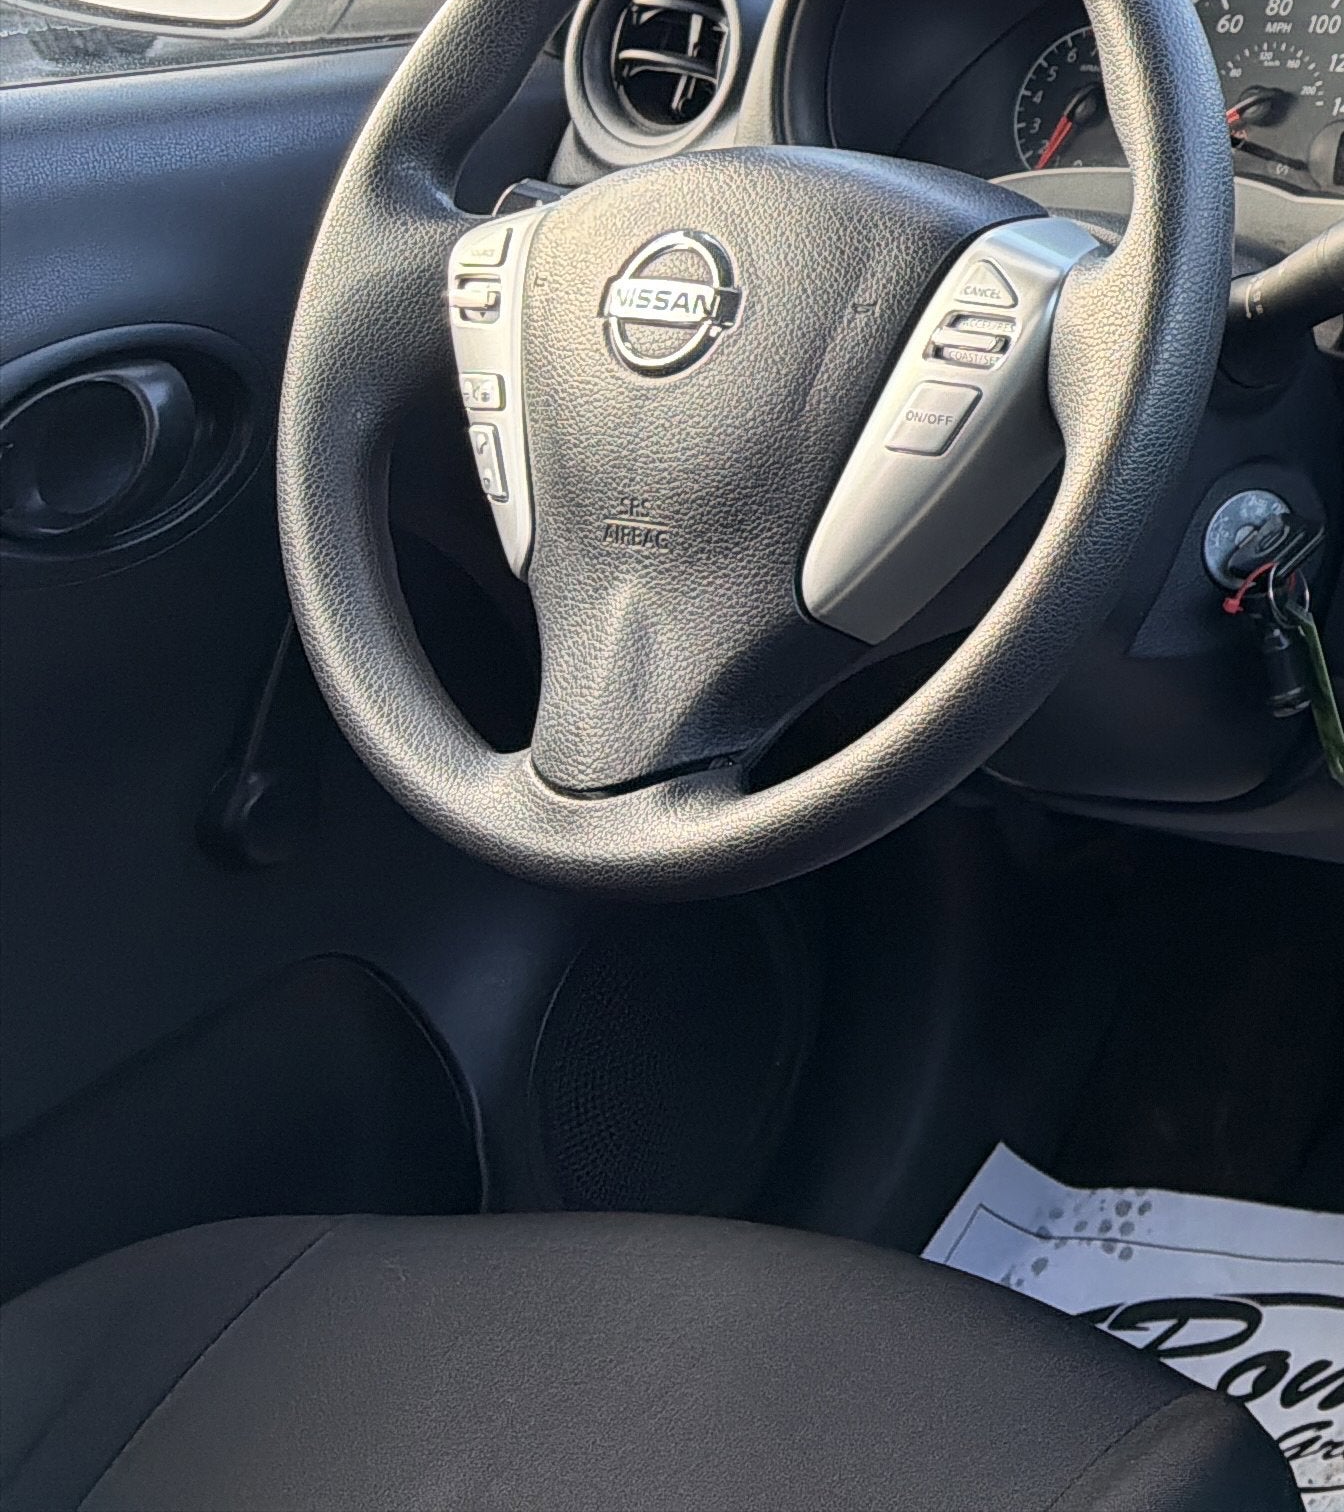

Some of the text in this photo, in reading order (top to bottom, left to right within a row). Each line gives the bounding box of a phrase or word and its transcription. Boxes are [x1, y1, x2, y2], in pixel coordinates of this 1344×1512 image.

[1216, 14, 1244, 34] 60
[1265, 21, 1293, 34] MPH
[1307, 14, 1342, 34] 100
[1066, 48, 1078, 64] 6
[1046, 65, 1058, 82] 5
[1032, 90, 1044, 104] 4
[1029, 117, 1041, 134] 3
[615, 287, 715, 315] NISSAN
[962, 285, 1002, 300] CANCEL
[905, 409, 954, 426] ON/OFF
